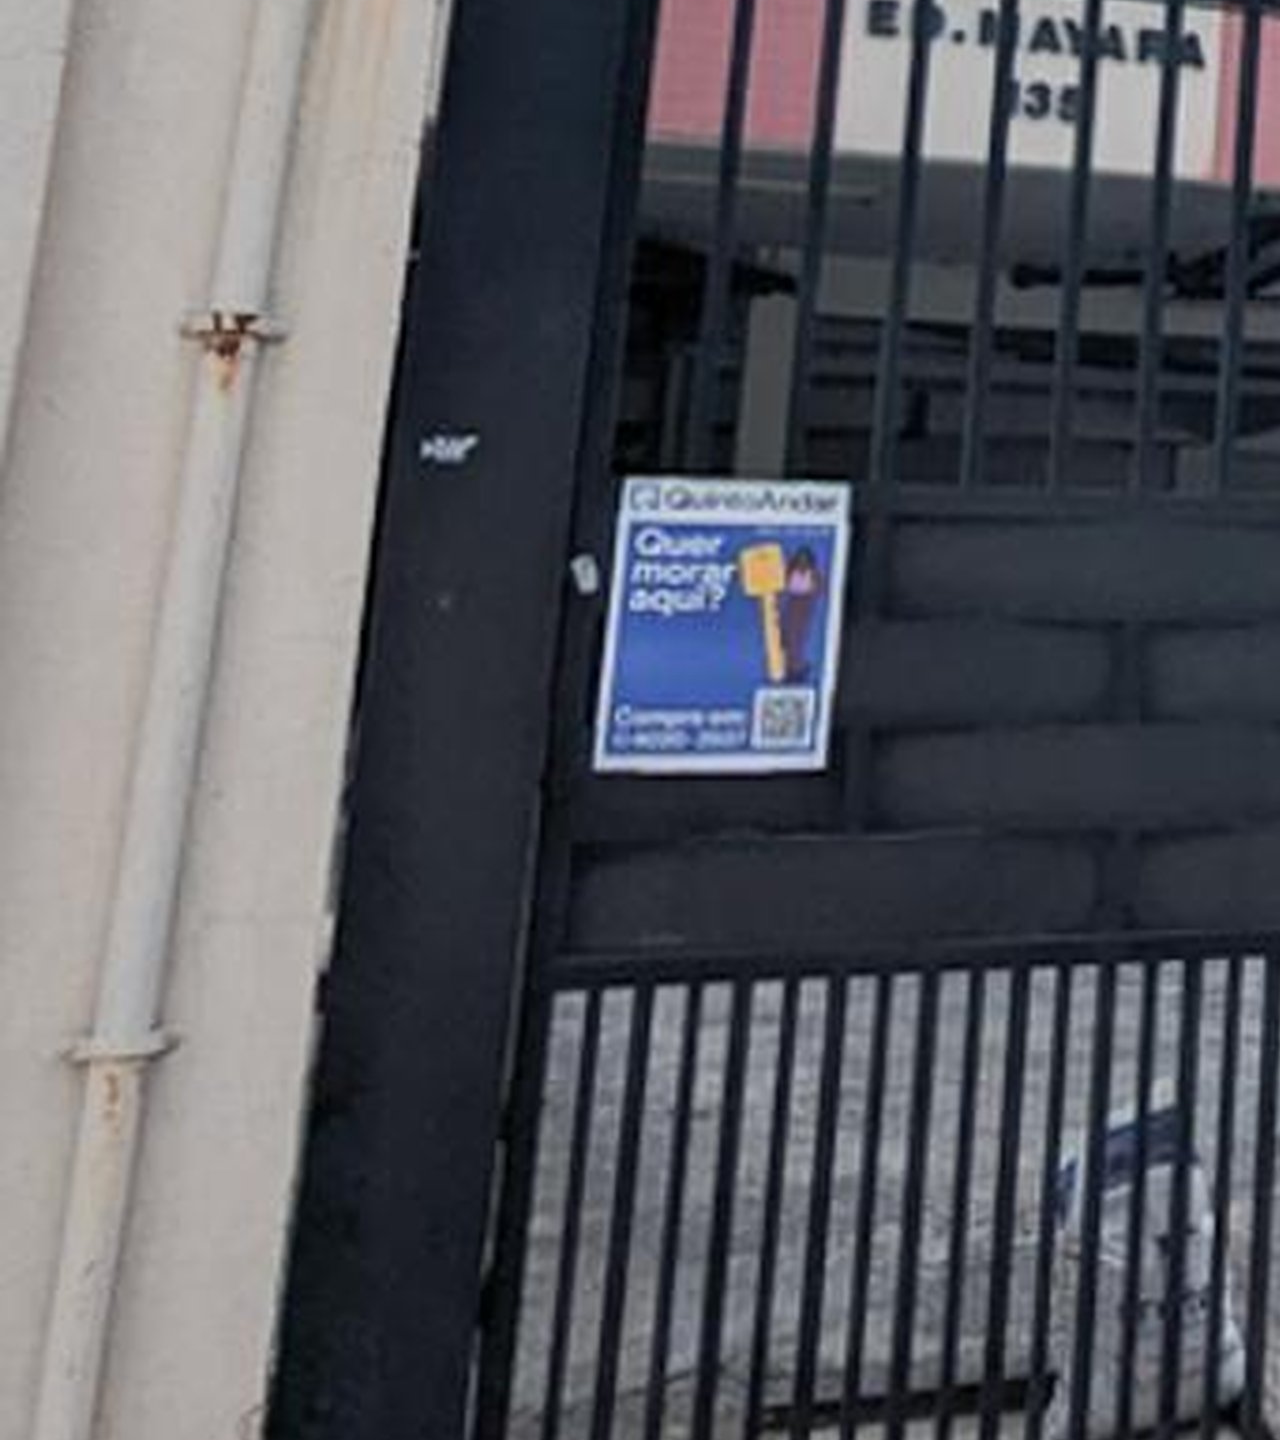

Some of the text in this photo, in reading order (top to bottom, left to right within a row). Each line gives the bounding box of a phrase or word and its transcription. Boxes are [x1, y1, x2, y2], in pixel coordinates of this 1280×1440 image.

[664, 484, 839, 514] QuintoAndar
[634, 528, 723, 556] Quer
[631, 562, 737, 586] morar
[629, 584, 726, 616] aqui?
